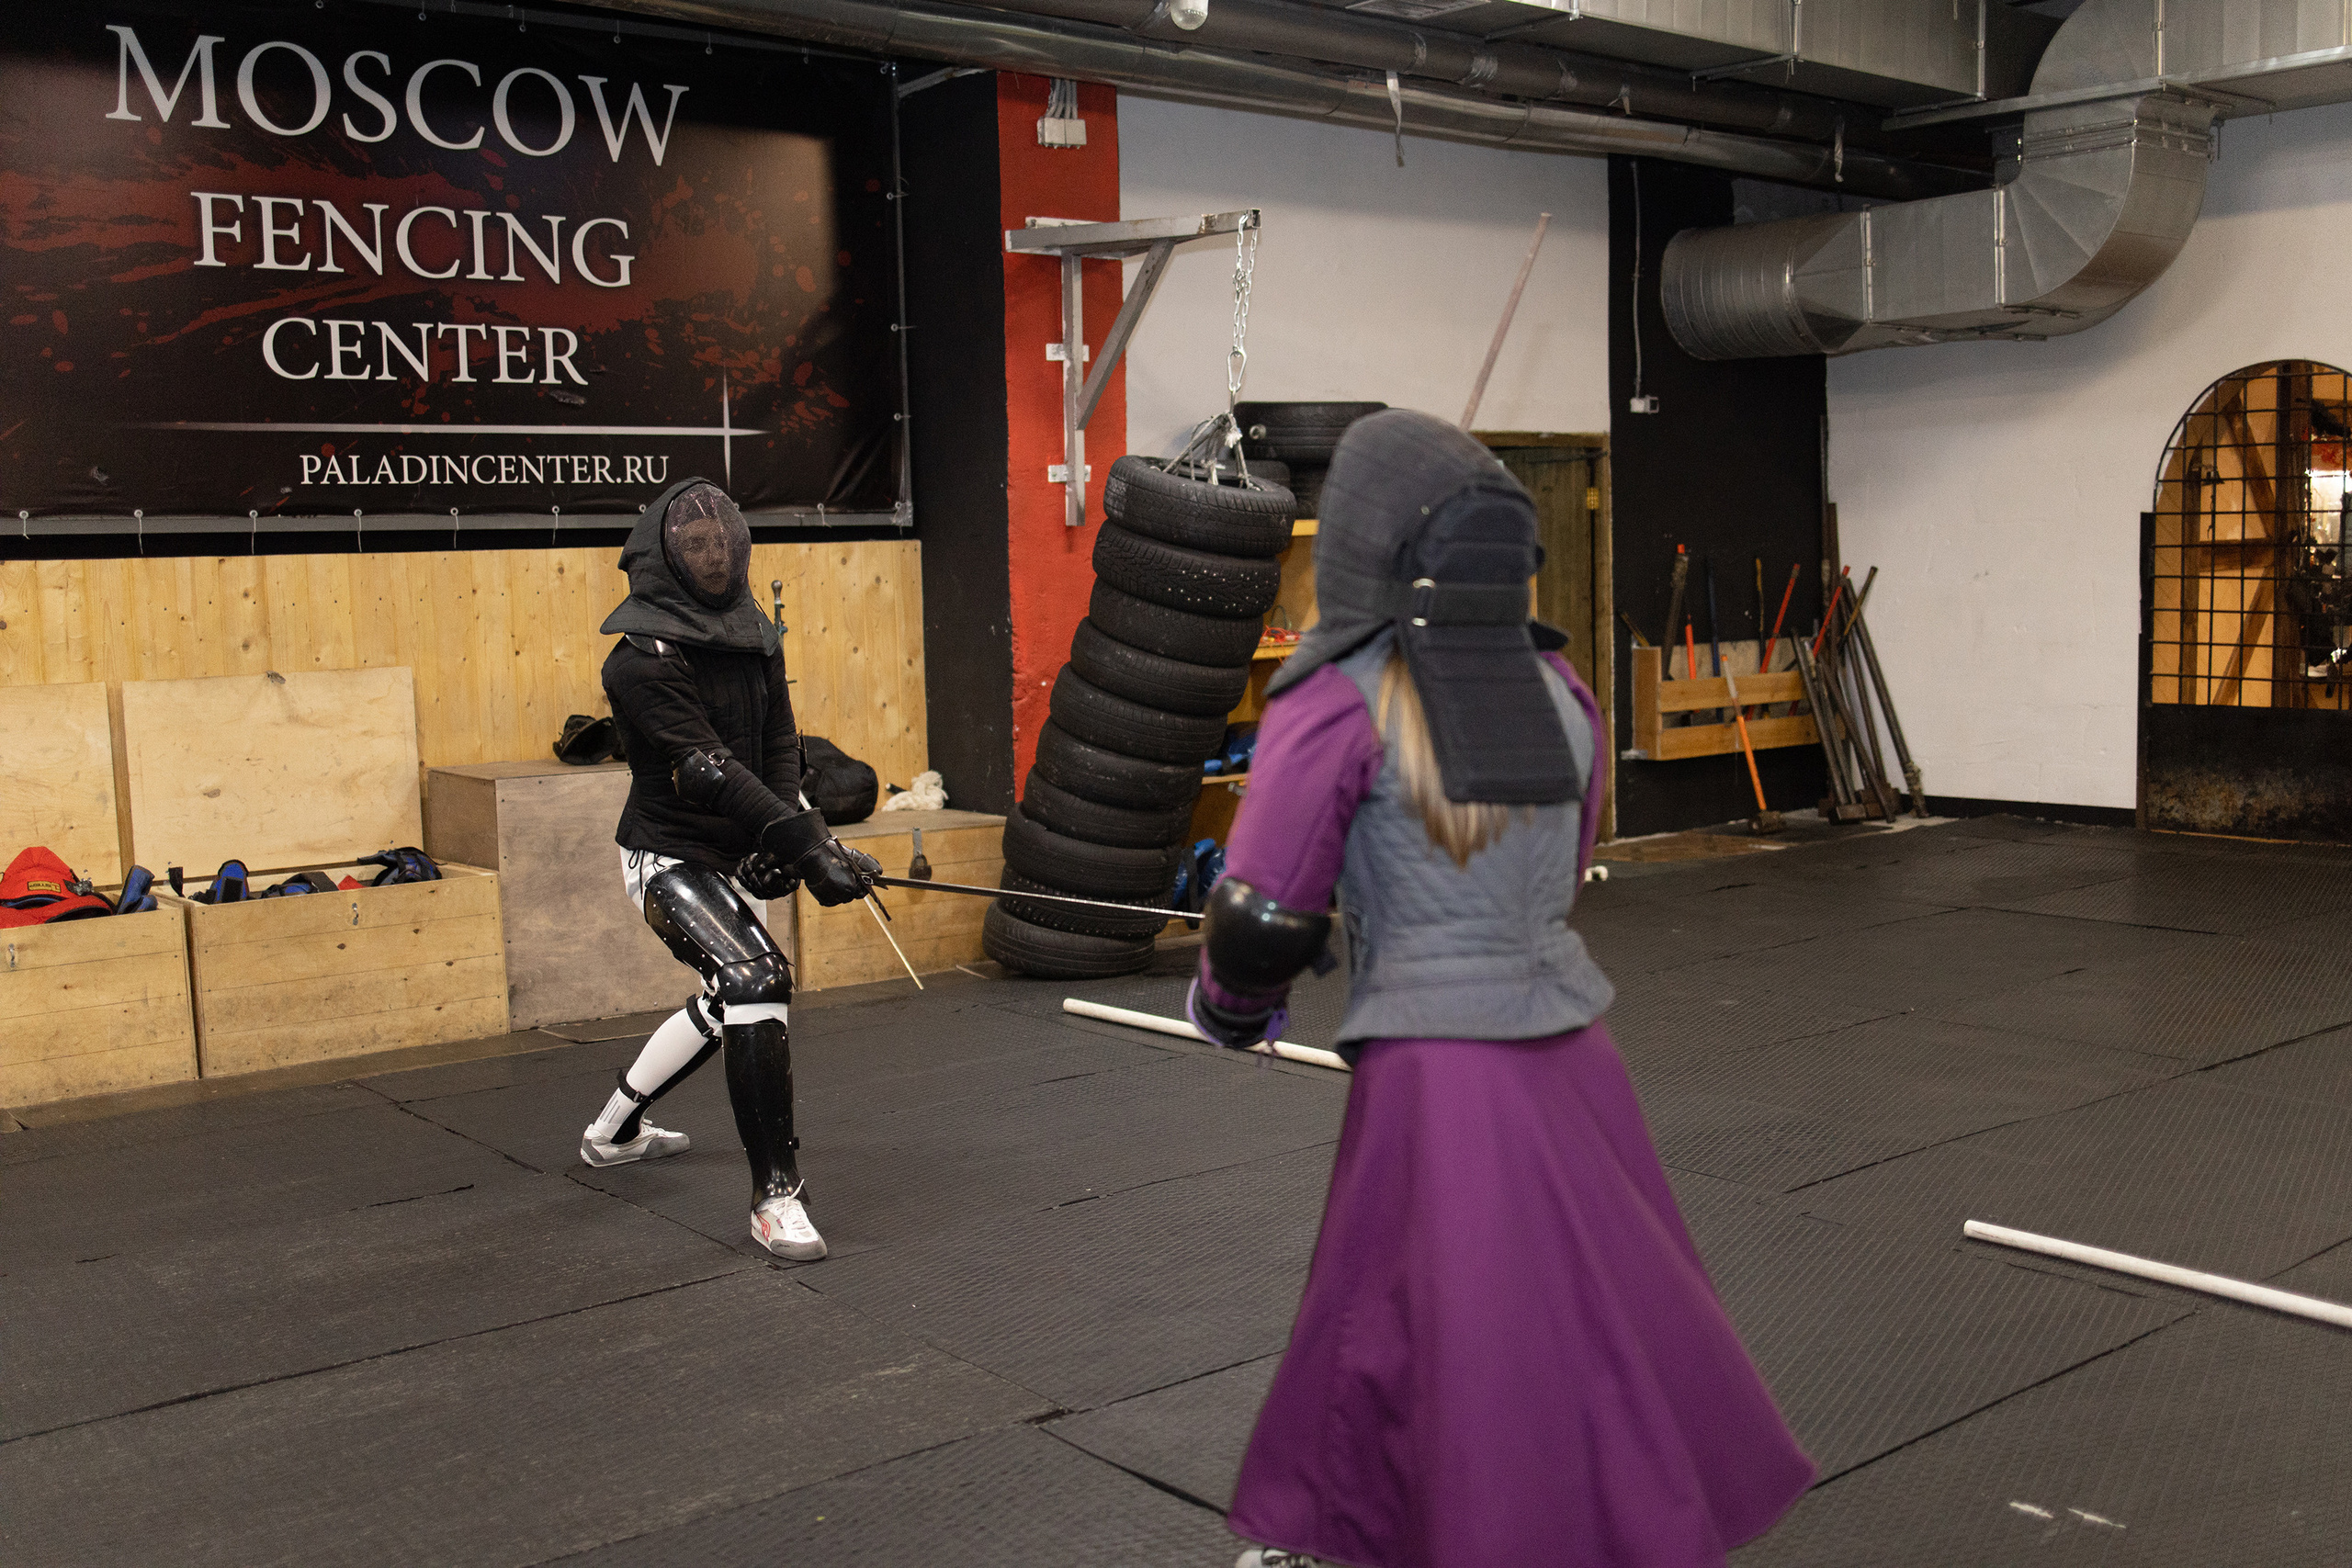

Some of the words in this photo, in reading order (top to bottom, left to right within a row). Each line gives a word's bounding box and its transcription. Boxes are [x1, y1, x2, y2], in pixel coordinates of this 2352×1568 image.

[105, 25, 690, 166] MOSCOW
[190, 191, 636, 288] FENCING
[262, 317, 589, 386] CENTER
[299, 455, 669, 485] PALADINCENTER.RU
